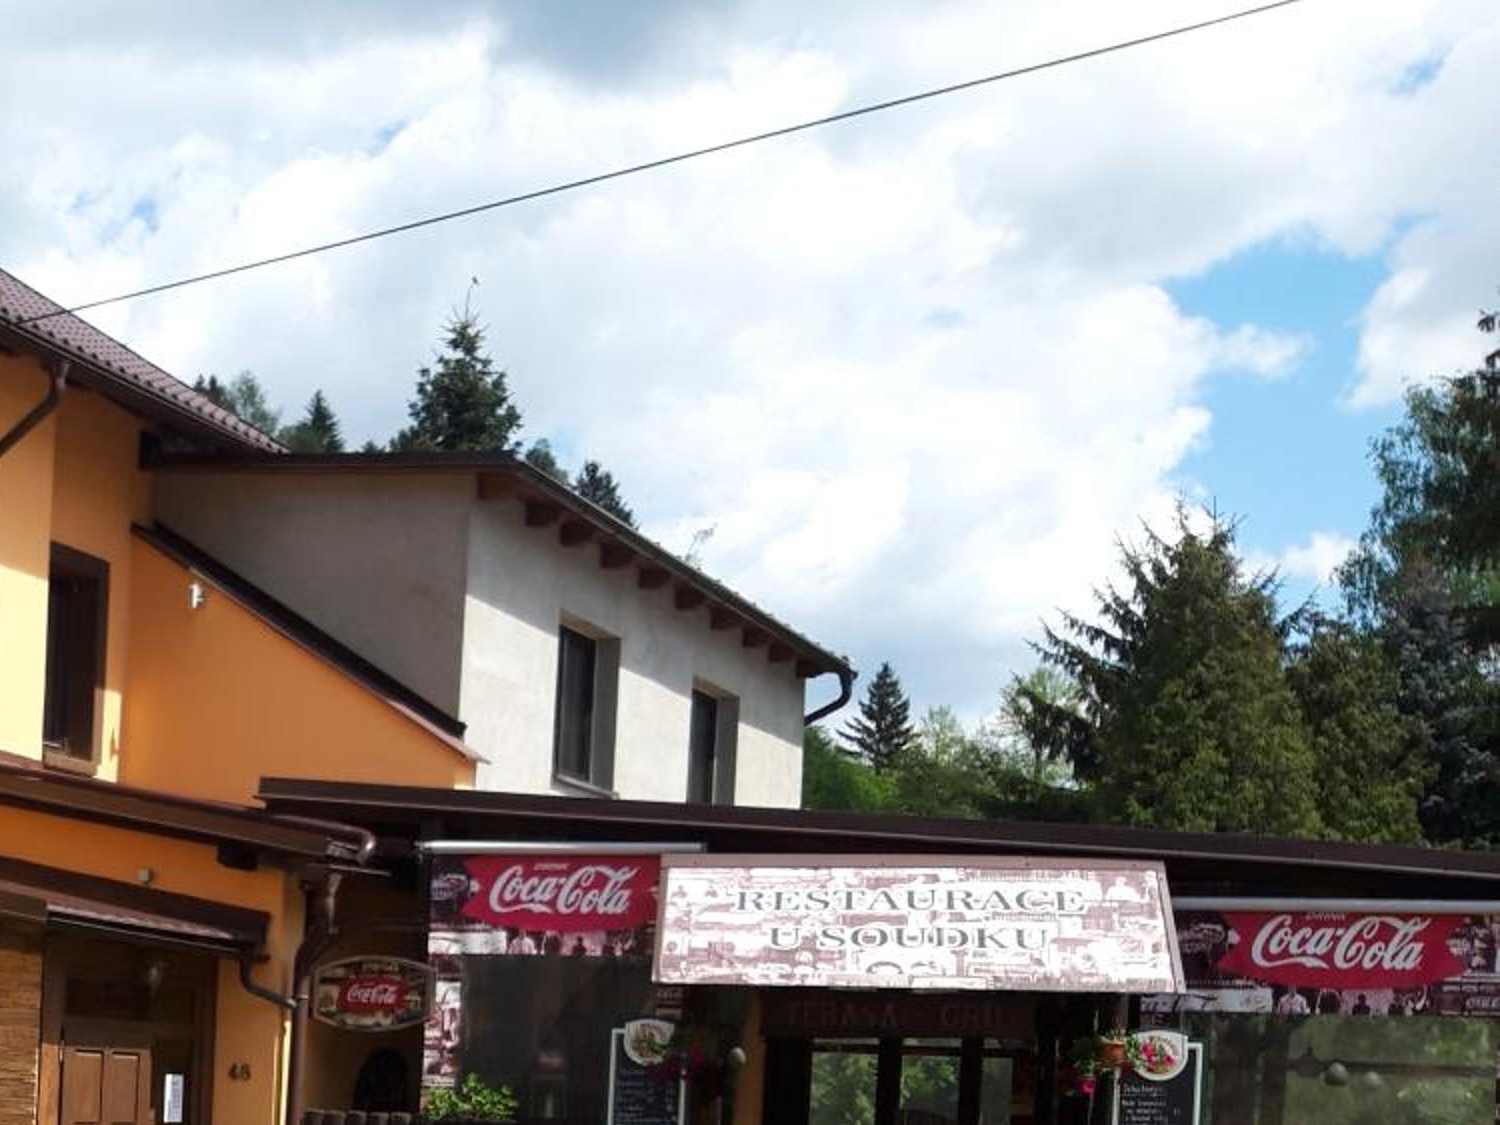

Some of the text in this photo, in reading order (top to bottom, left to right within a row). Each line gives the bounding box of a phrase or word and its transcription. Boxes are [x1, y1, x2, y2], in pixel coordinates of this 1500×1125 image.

[489, 864, 642, 915] Coca-Cola
[734, 888, 1086, 914] RESTAURACE
[769, 926, 1049, 950] U SOUDKU
[1251, 914, 1432, 971] Coca-Cola
